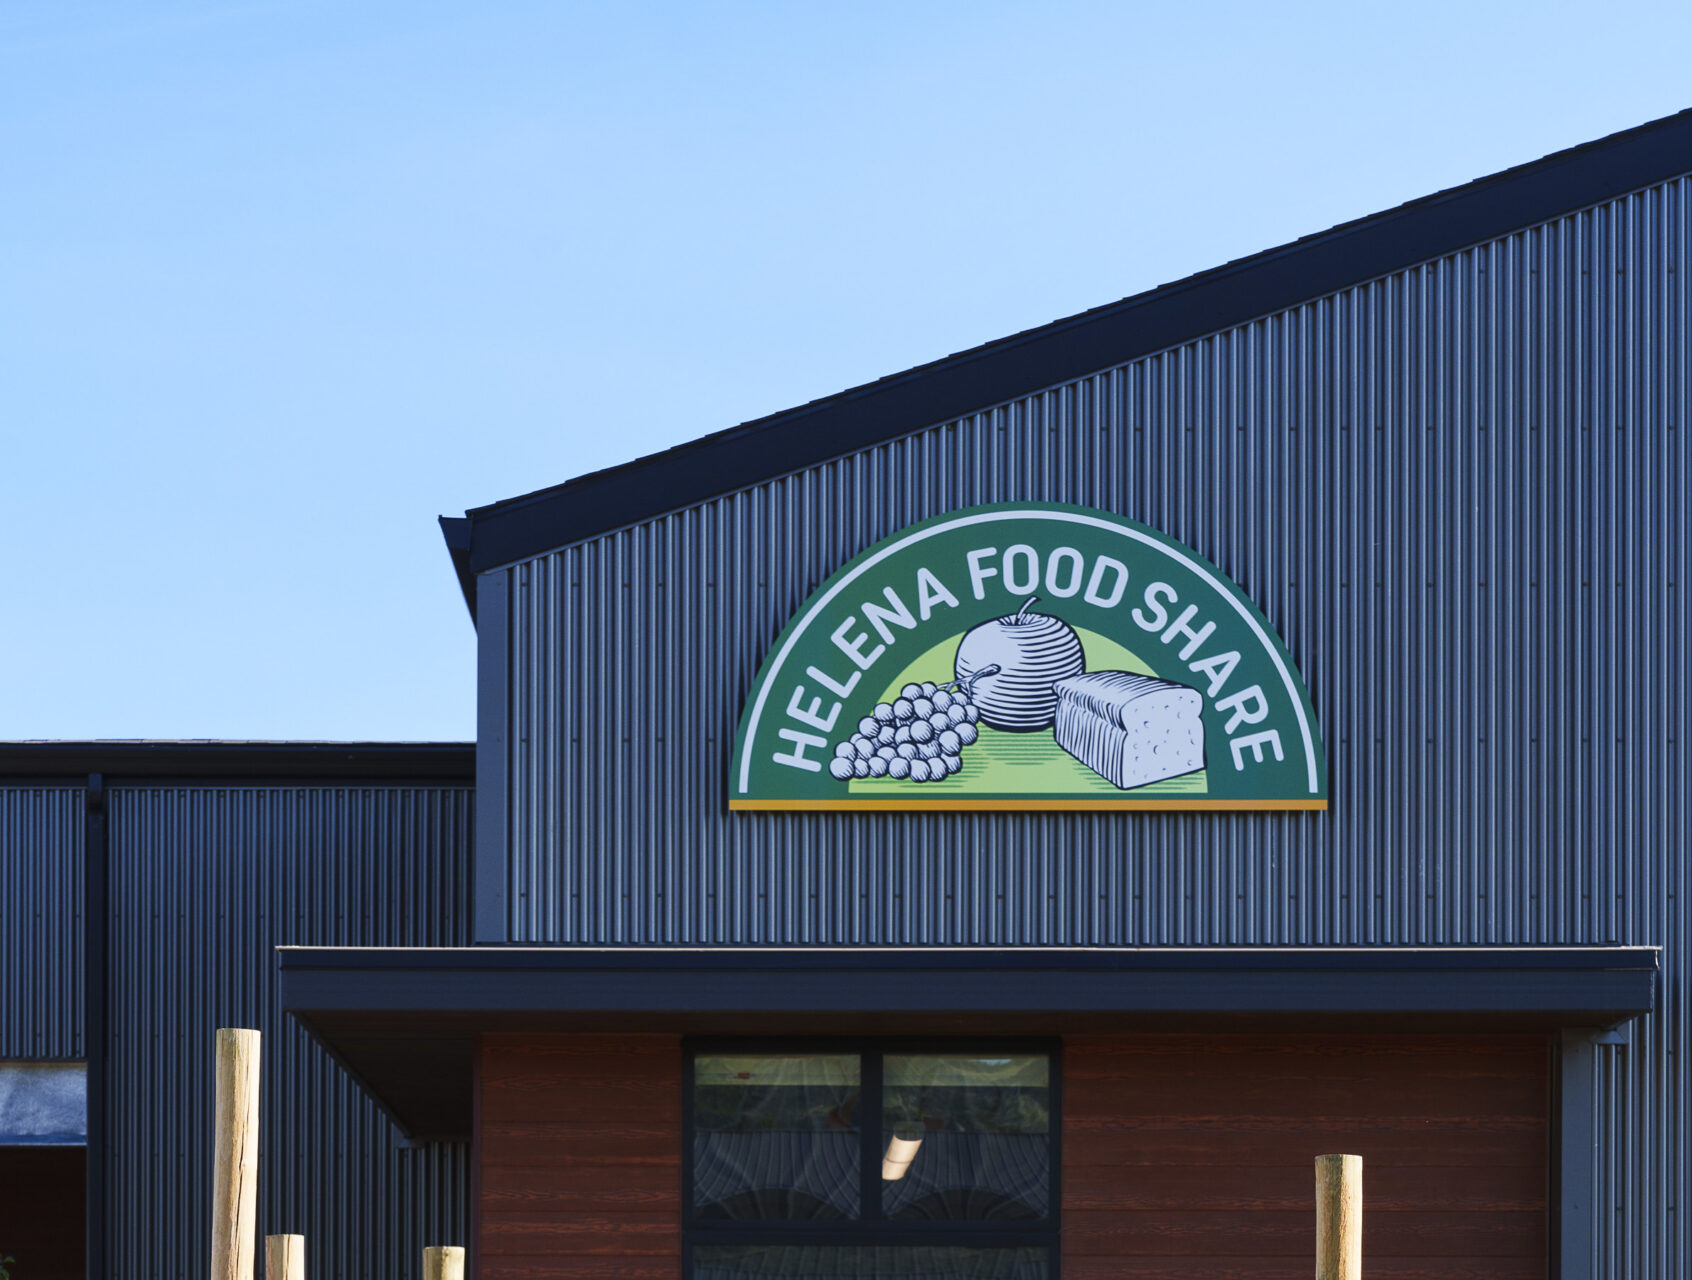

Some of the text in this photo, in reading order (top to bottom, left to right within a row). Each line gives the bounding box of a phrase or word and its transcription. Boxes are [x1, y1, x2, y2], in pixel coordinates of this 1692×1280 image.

[773, 544, 1284, 772] HELENA FOOD SHARE
